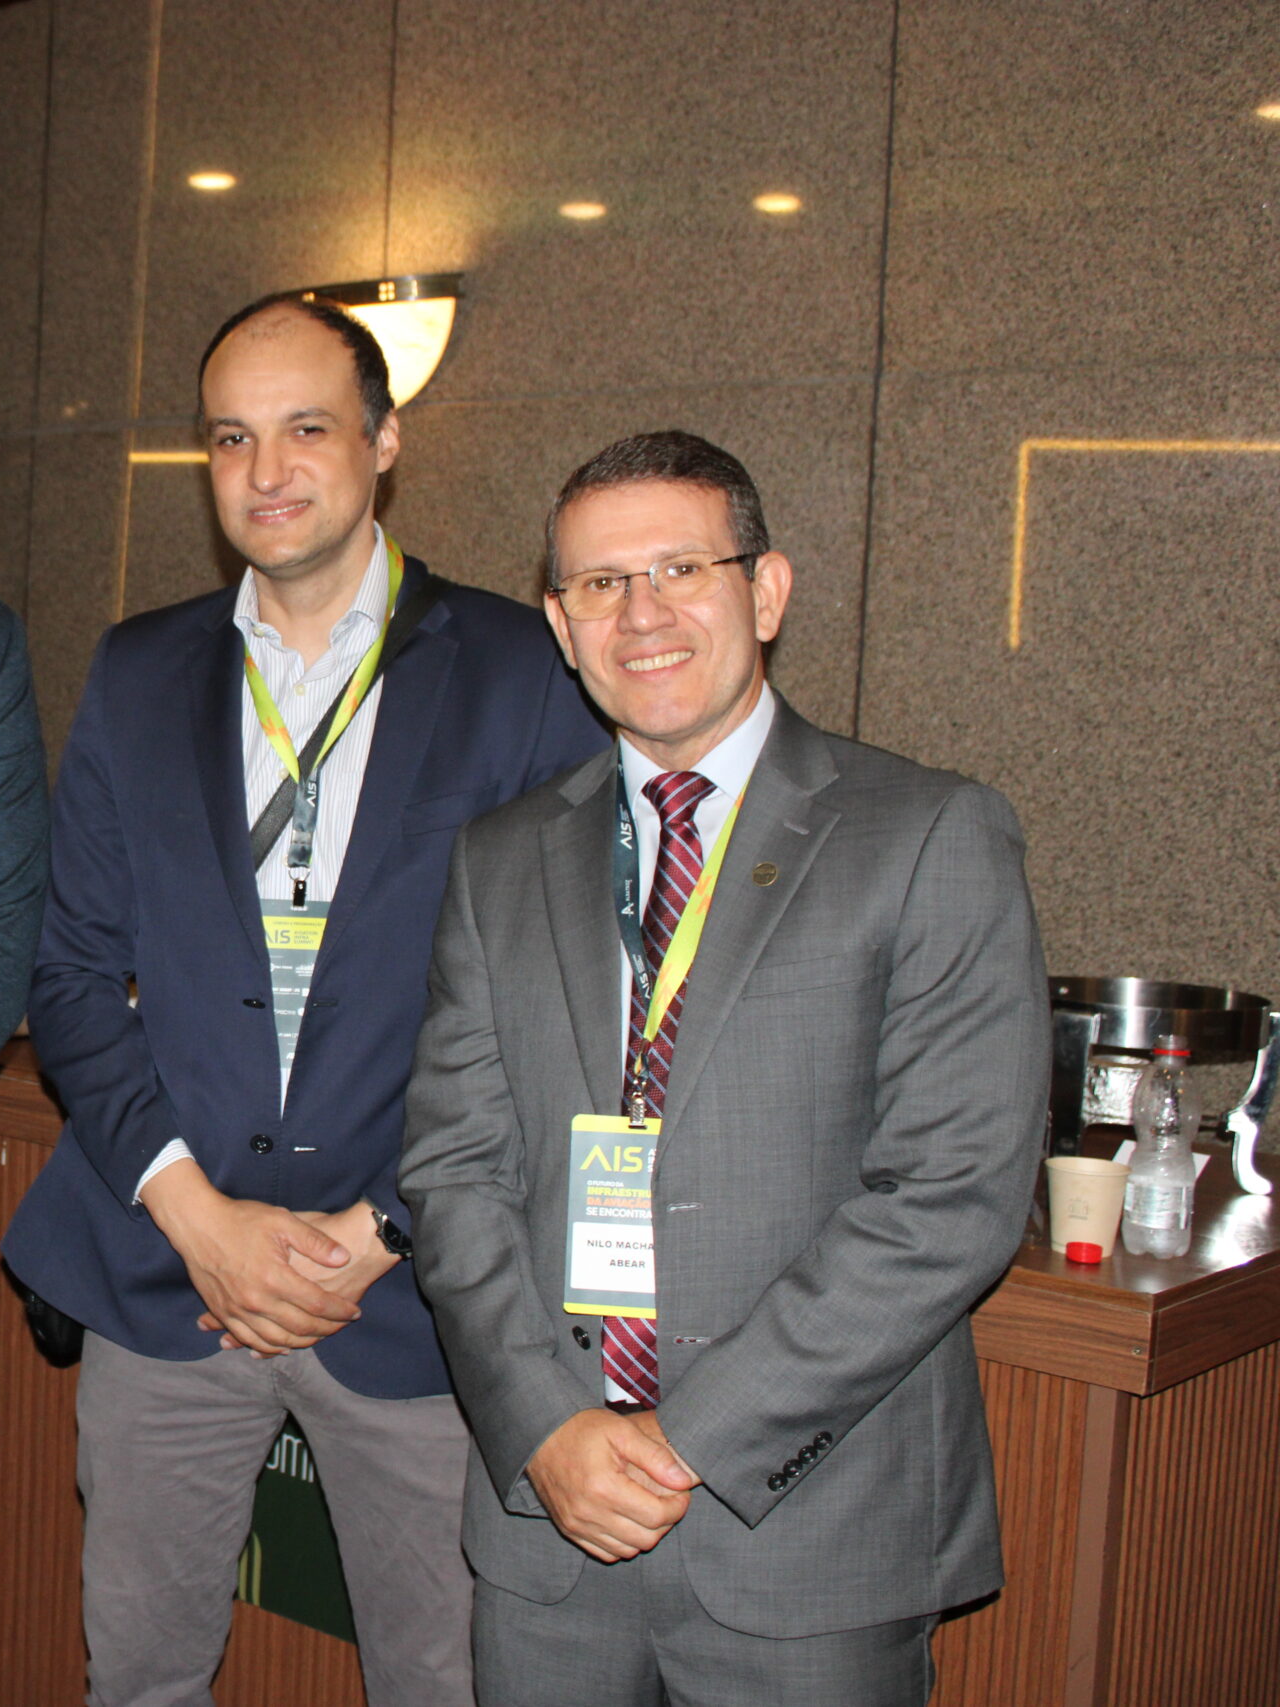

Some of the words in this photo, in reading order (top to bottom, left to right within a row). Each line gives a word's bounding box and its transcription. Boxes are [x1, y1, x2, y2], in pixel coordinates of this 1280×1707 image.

[579, 1144, 644, 1173] AIS
[585, 1206, 598, 1216] SE
[598, 1206, 653, 1219] ENCONTRA
[587, 1239, 613, 1248] NILO
[609, 1259, 646, 1268] ABEAR
